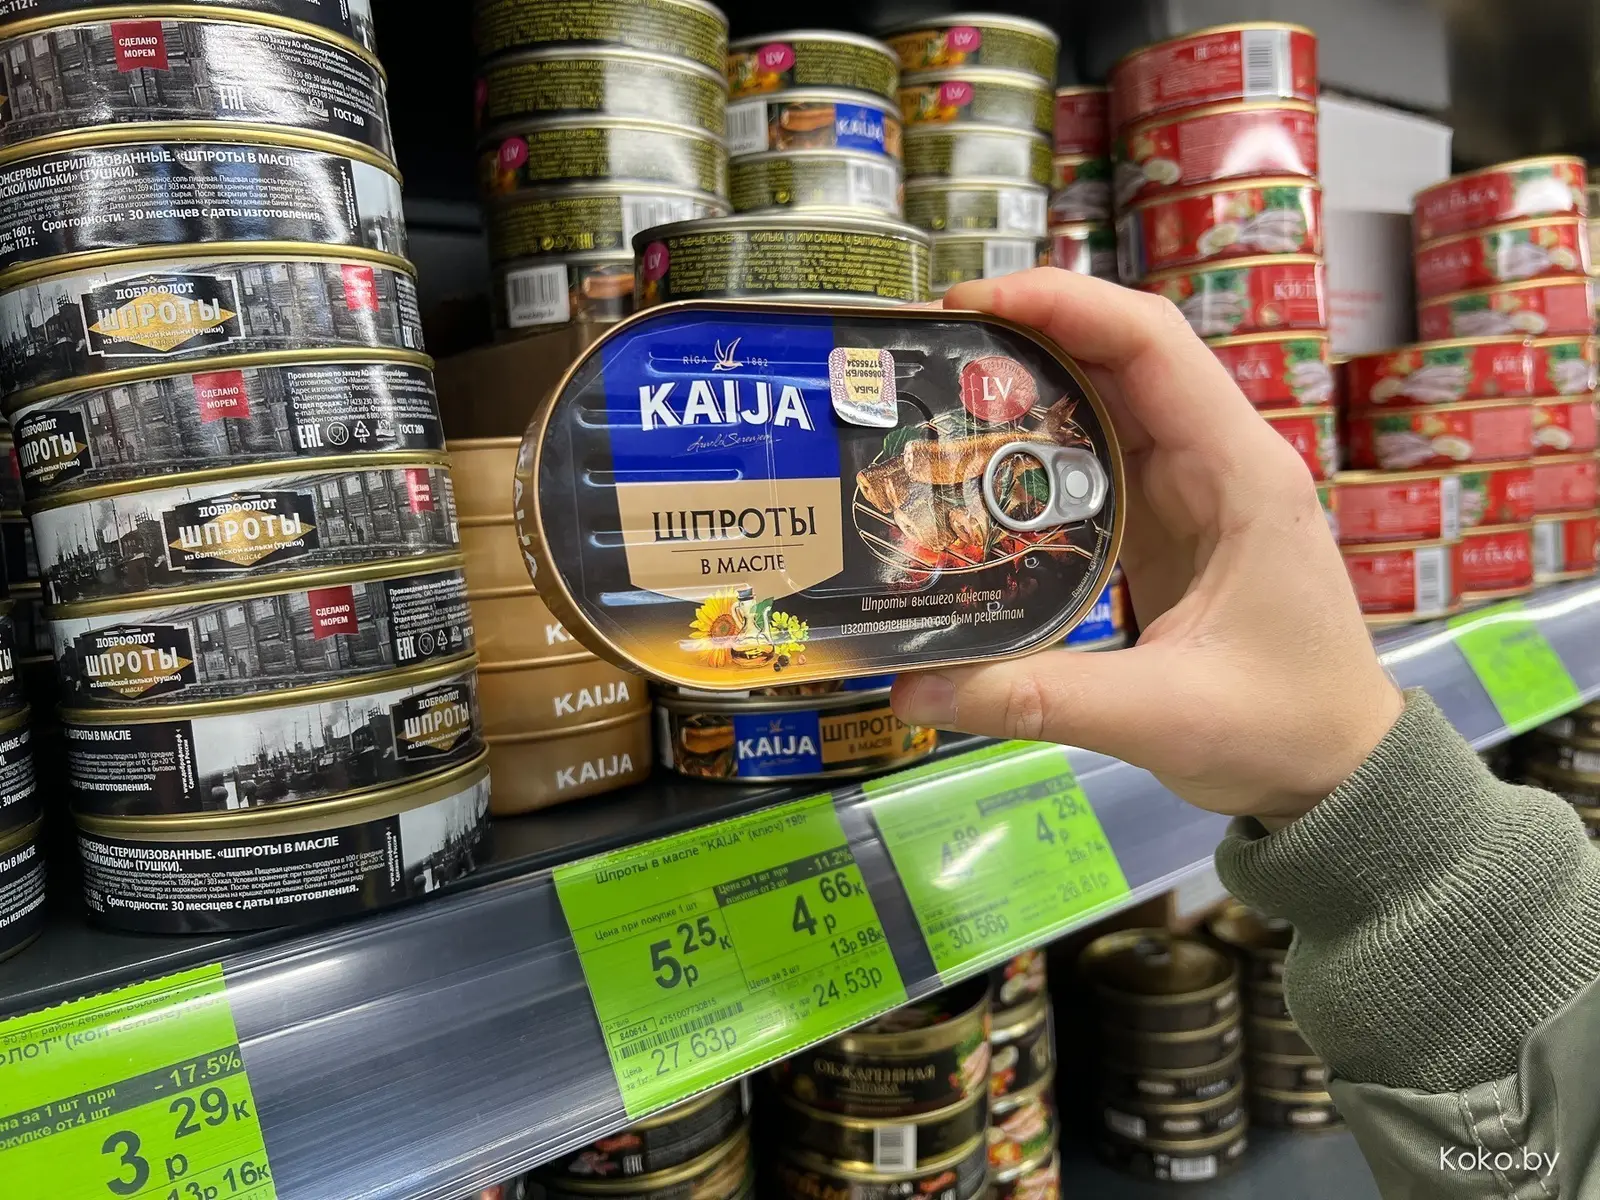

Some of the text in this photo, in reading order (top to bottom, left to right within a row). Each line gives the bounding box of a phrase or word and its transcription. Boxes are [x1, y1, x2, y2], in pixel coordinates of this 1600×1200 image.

[119, 37, 158, 47] СДЕЛАНО
[124, 49, 156, 58] МОРЕМ
[333, 107, 365, 126] ГОСТ 280
[43, 151, 176, 174] СТЕРИЛИЗОВАННЫЕ.
[176, 151, 246, 163] «ШПРОТЫ
[258, 154, 300, 167] МАСЛЕ
[28, 165, 138, 191] КИЛЬКИ» (ТУШКИ).
[12, 226, 27, 238] 160
[42, 219, 68, 233] Срок
[69, 213, 125, 229] годности:
[129, 209, 144, 220] 30
[146, 208, 199, 219] месяцев
[210, 208, 242, 218] даты
[243, 208, 323, 221] изготовления.
[16, 237, 31, 250] 112
[114, 282, 195, 300] ДОБРОФЛОТ
[97, 298, 221, 331] ШПРОТЫ
[201, 387, 239, 399] СДЕЛАНО
[853, 384, 879, 395] РЫБА
[981, 376, 1014, 402] LV
[207, 399, 238, 409] МОРЕМ
[639, 379, 816, 431] KAIJA
[198, 498, 277, 518] ДОБРОФЛОТ
[179, 512, 302, 548] ШПРОТЫ
[652, 506, 818, 543] ШПРОТЫ
[194, 538, 306, 560] балтийской кильки (тушки)
[700, 554, 786, 575] В МАСЛЕ
[315, 604, 350, 617] СДЕЛАНО
[861, 589, 1002, 613] Шпроты высшего качества
[320, 615, 349, 627] МОРЕМ
[934, 609, 973, 628] особым
[974, 607, 1025, 626] рецептам
[96, 632, 156, 650] ДОБРОФЛОТ
[85, 646, 179, 678] ШПРОТЫ
[153, 672, 182, 684] (тушки)
[418, 690, 460, 710] ДОБРОФЛОТ
[553, 681, 630, 717] KAIJA
[404, 701, 470, 740] ШПРОТЫ
[100, 730, 132, 741] МАСЛЕ
[737, 735, 817, 760] KAIJA
[556, 753, 634, 790] KAIJA
[95, 782, 152, 792] изготовления.
[1036, 811, 1055, 845] 4
[110, 836, 339, 860] СТЕРИЛИЗОВАННЫЕ. «ШПРОТЫ В МАСЛЕ
[594, 862, 649, 885] Шпроты
[652, 858, 660, 868] в
[663, 846, 700, 865] масле
[700, 829, 745, 852] "KAIJA"
[748, 820, 785, 841] (ключ)
[100, 856, 183, 873] КИЛЬКИ» (ТУШКИ).
[107, 895, 125, 907] Срок
[125, 901, 169, 911] годности:
[171, 901, 184, 911] 30
[186, 901, 233, 911] месяцев
[243, 897, 273, 910] даты
[275, 883, 360, 905] изготовления.
[793, 872, 864, 936] 4 р 66 к
[595, 928, 619, 941] Цена
[621, 921, 640, 933] при
[641, 908, 677, 925] покупке
[685, 902, 698, 912] шт
[650, 916, 732, 989] 5 р 25 к
[830, 927, 884, 958] 13р 98к
[782, 967, 789, 977] 3
[813, 967, 882, 1008] 24.53р
[41, 1020, 76, 1037] район
[78, 1006, 124, 1027] деревни
[620, 1025, 648, 1041] 840614
[651, 1025, 738, 1077] 27.63р
[622, 1066, 643, 1079] Цена
[22, 1111, 40, 1125] за
[44, 1104, 53, 1117] 1
[57, 1098, 80, 1114] шт
[87, 1087, 117, 1108] при
[56, 1119, 73, 1132] от
[77, 1113, 87, 1125] 4
[89, 1105, 111, 1121] шт
[101, 1087, 251, 1196] 3 р 29 к
[222, 1161, 270, 1193] 16к
